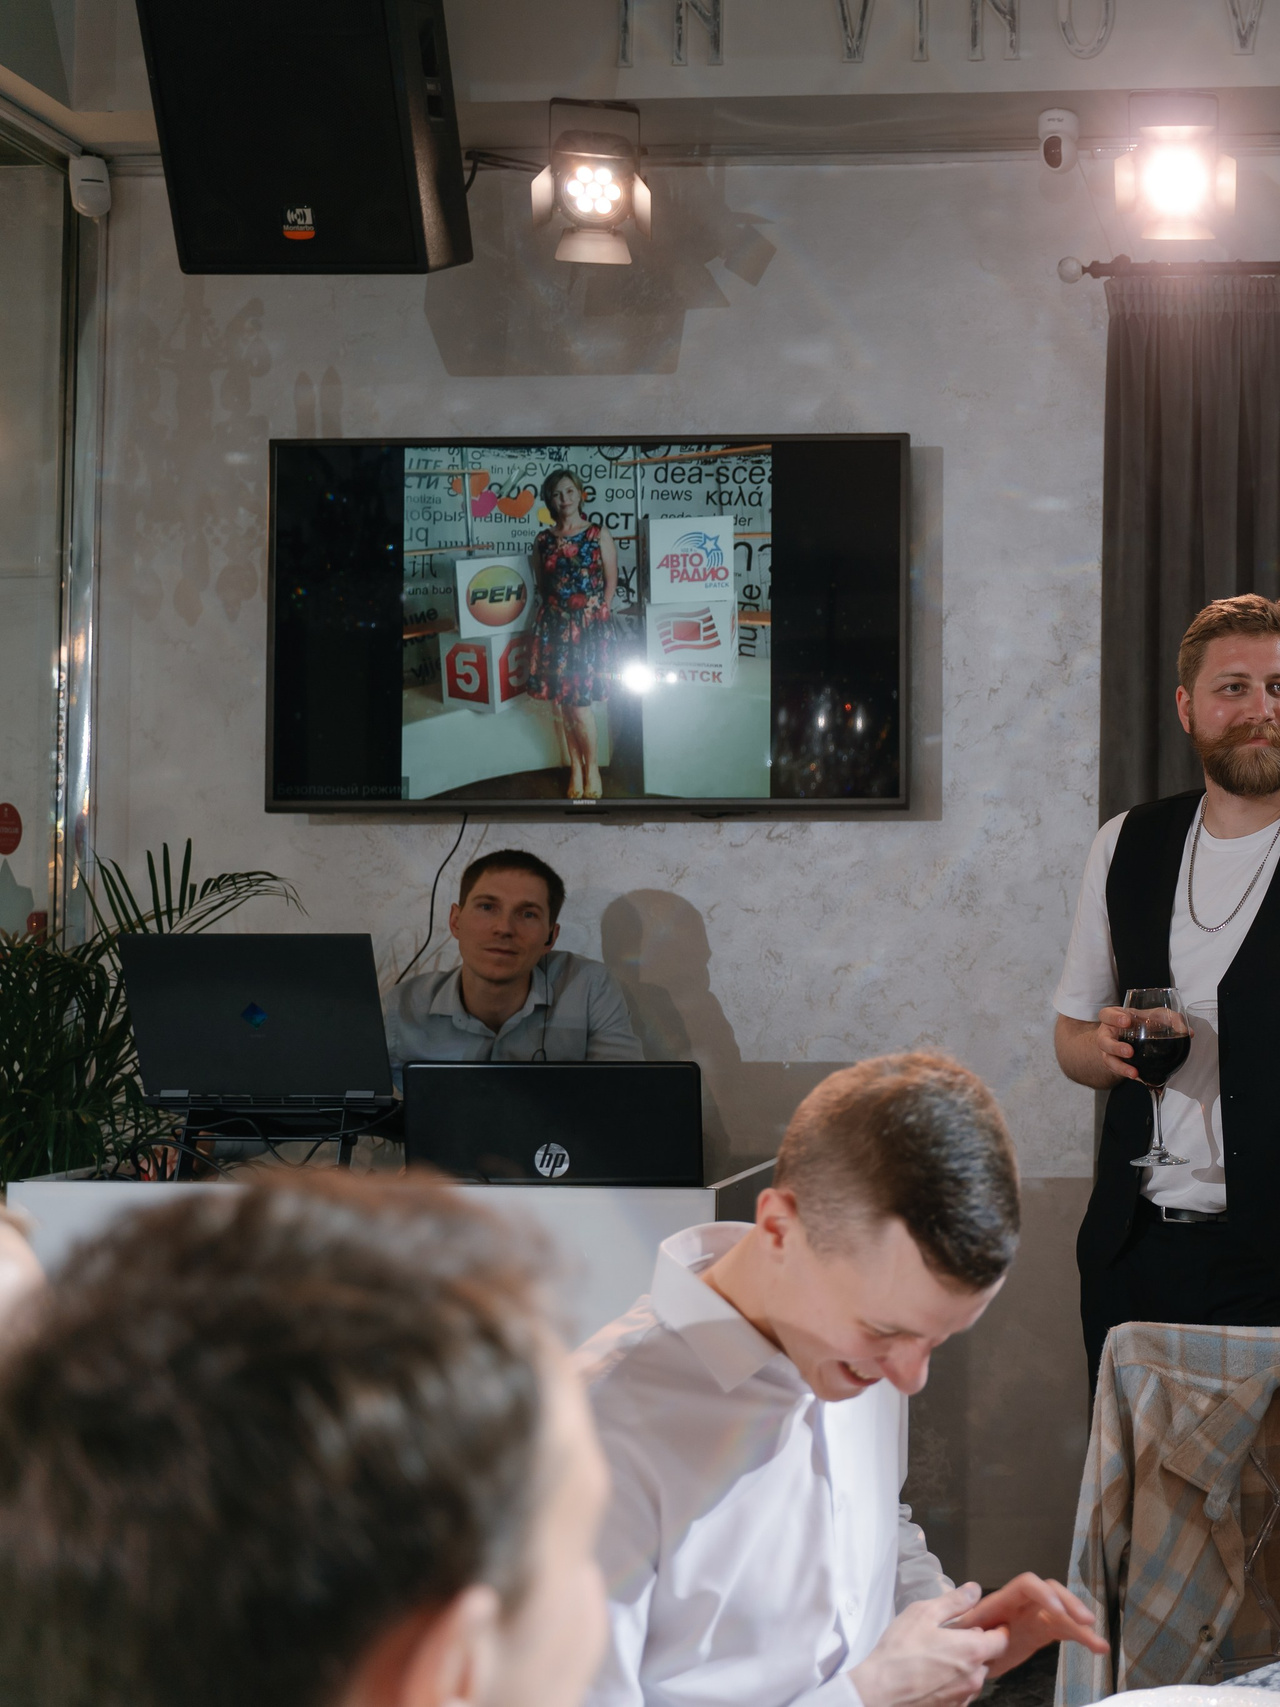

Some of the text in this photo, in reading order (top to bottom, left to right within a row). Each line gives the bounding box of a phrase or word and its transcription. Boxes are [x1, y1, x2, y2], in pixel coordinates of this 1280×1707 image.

[651, 489, 693, 501] news
[706, 485, 763, 507] καλά
[656, 552, 704, 570] АВТО
[670, 566, 729, 583] РАДИО
[470, 583, 524, 605] РЕН
[455, 651, 480, 694] 5
[539, 1143, 566, 1178] hp
